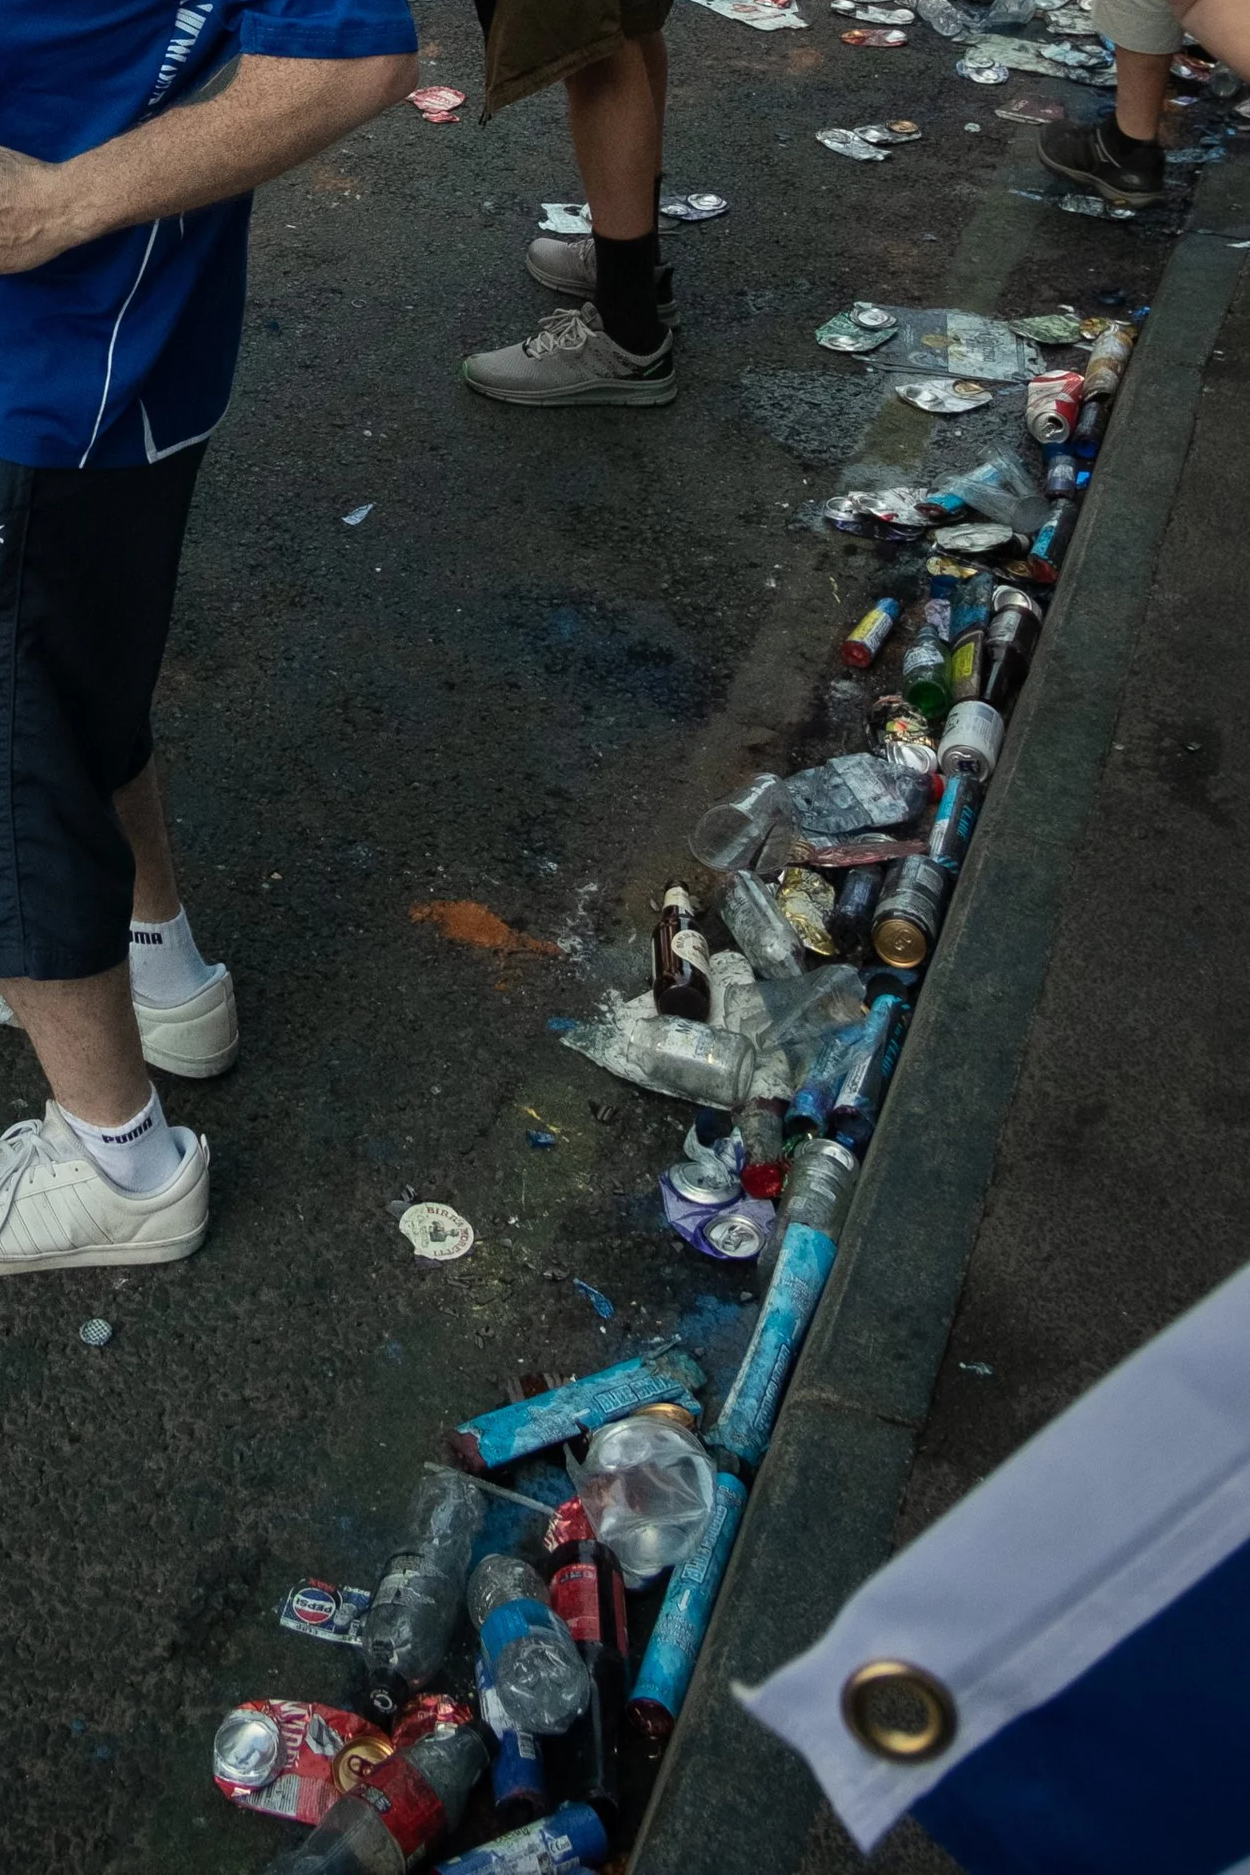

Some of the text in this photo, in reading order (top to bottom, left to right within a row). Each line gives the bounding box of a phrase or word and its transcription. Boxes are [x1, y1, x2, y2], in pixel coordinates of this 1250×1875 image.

[130, 931, 163, 946] MA
[101, 1116, 153, 1144] PUMA
[295, 1597, 333, 1613] PEPSI
